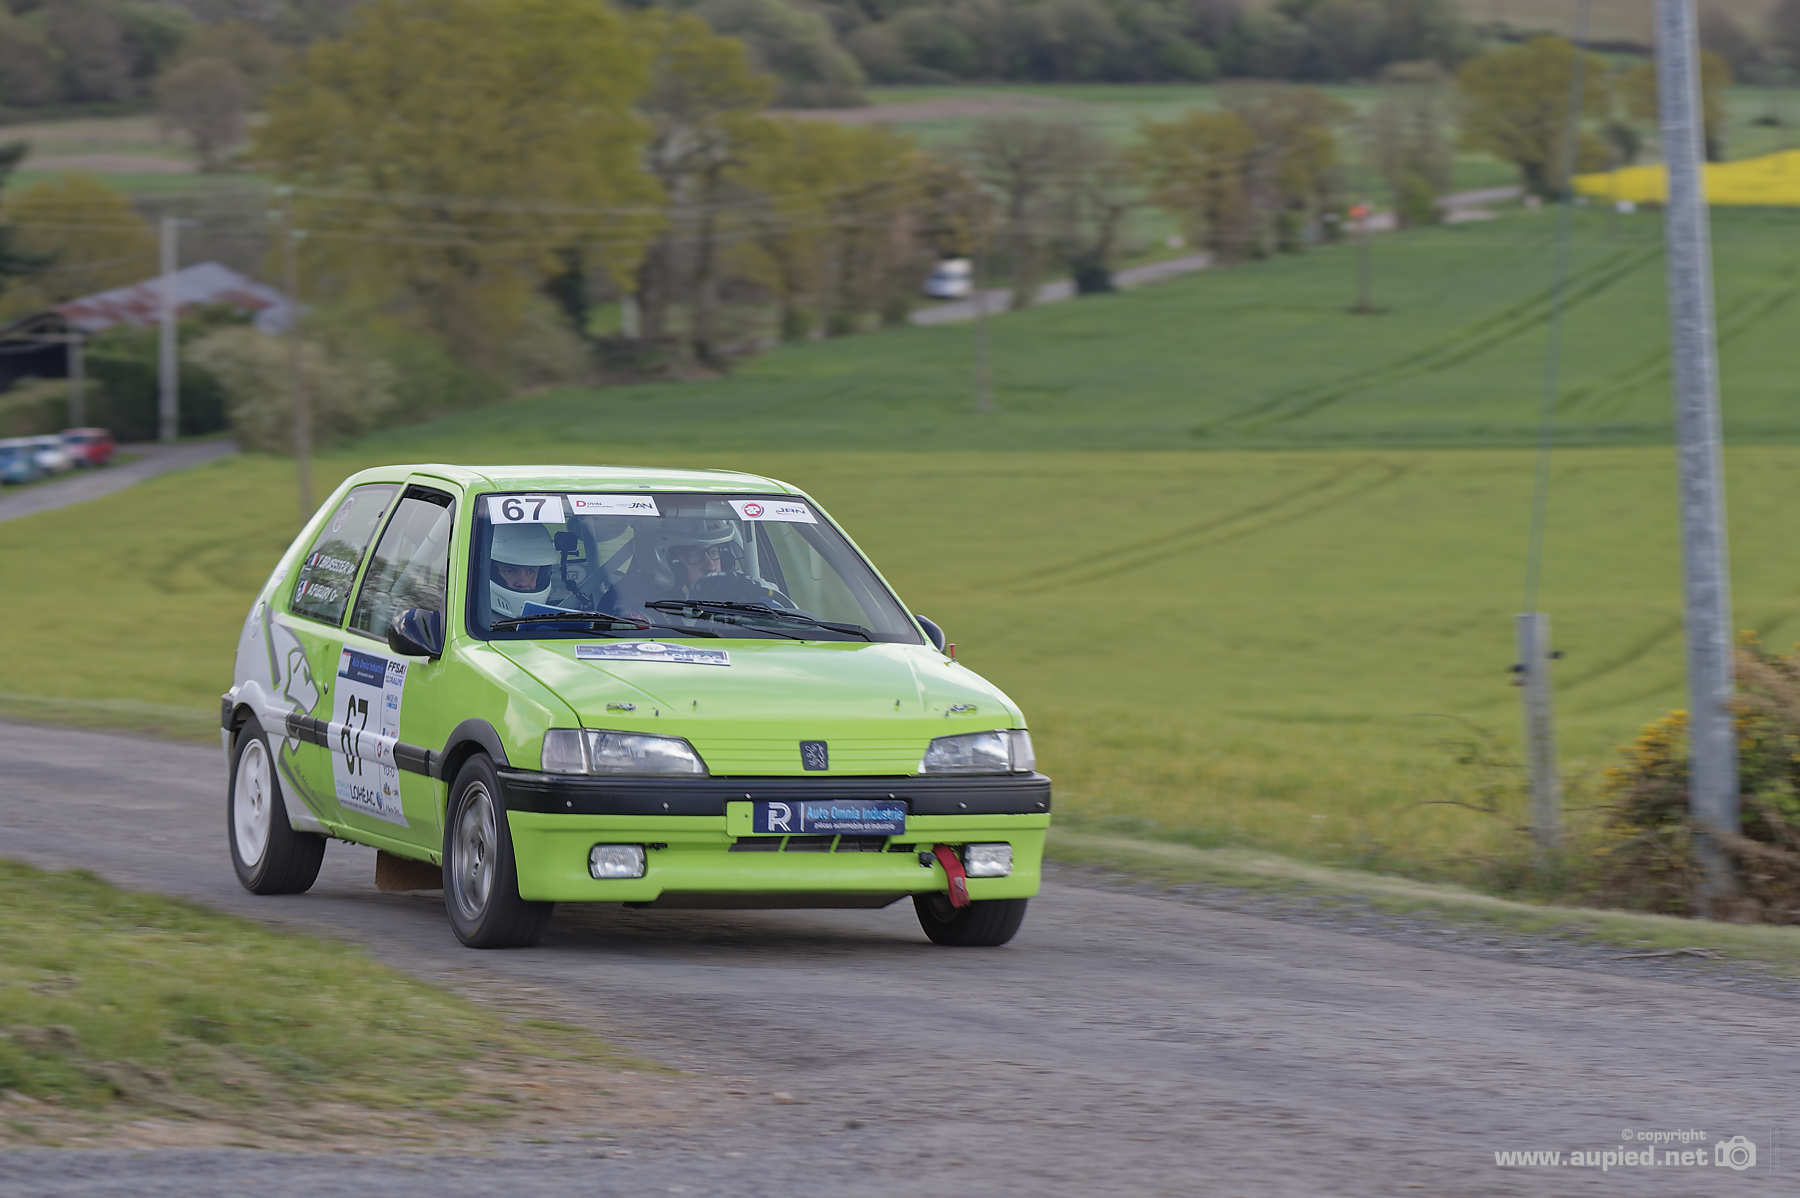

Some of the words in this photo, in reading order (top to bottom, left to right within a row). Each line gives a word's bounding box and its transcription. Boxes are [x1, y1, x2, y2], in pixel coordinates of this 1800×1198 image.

[502, 498, 546, 522] 67
[388, 660, 404, 674] FFSA
[341, 694, 368, 776] 67
[806, 807, 830, 820] Auto
[830, 807, 860, 820] Omnia
[862, 807, 903, 821] Industrie
